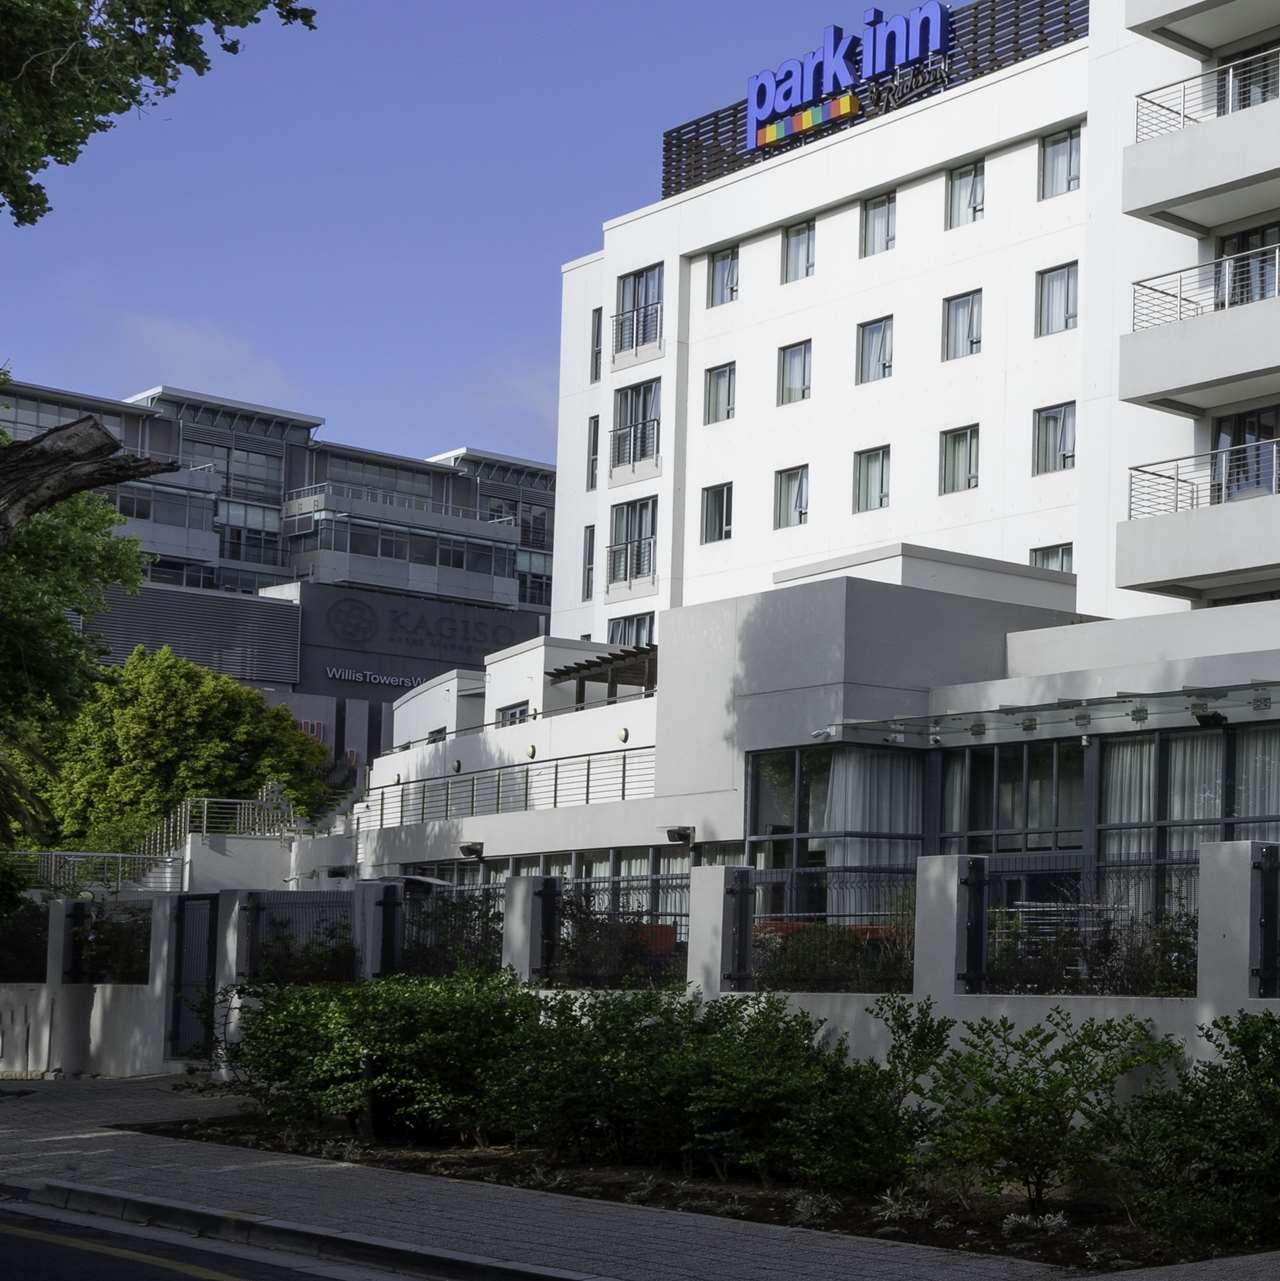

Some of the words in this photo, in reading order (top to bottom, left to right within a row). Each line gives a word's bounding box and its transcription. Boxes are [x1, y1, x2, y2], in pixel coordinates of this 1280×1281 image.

[747, 25, 859, 150] park
[861, 0, 949, 79] inn
[387, 609, 515, 645] KAGISO
